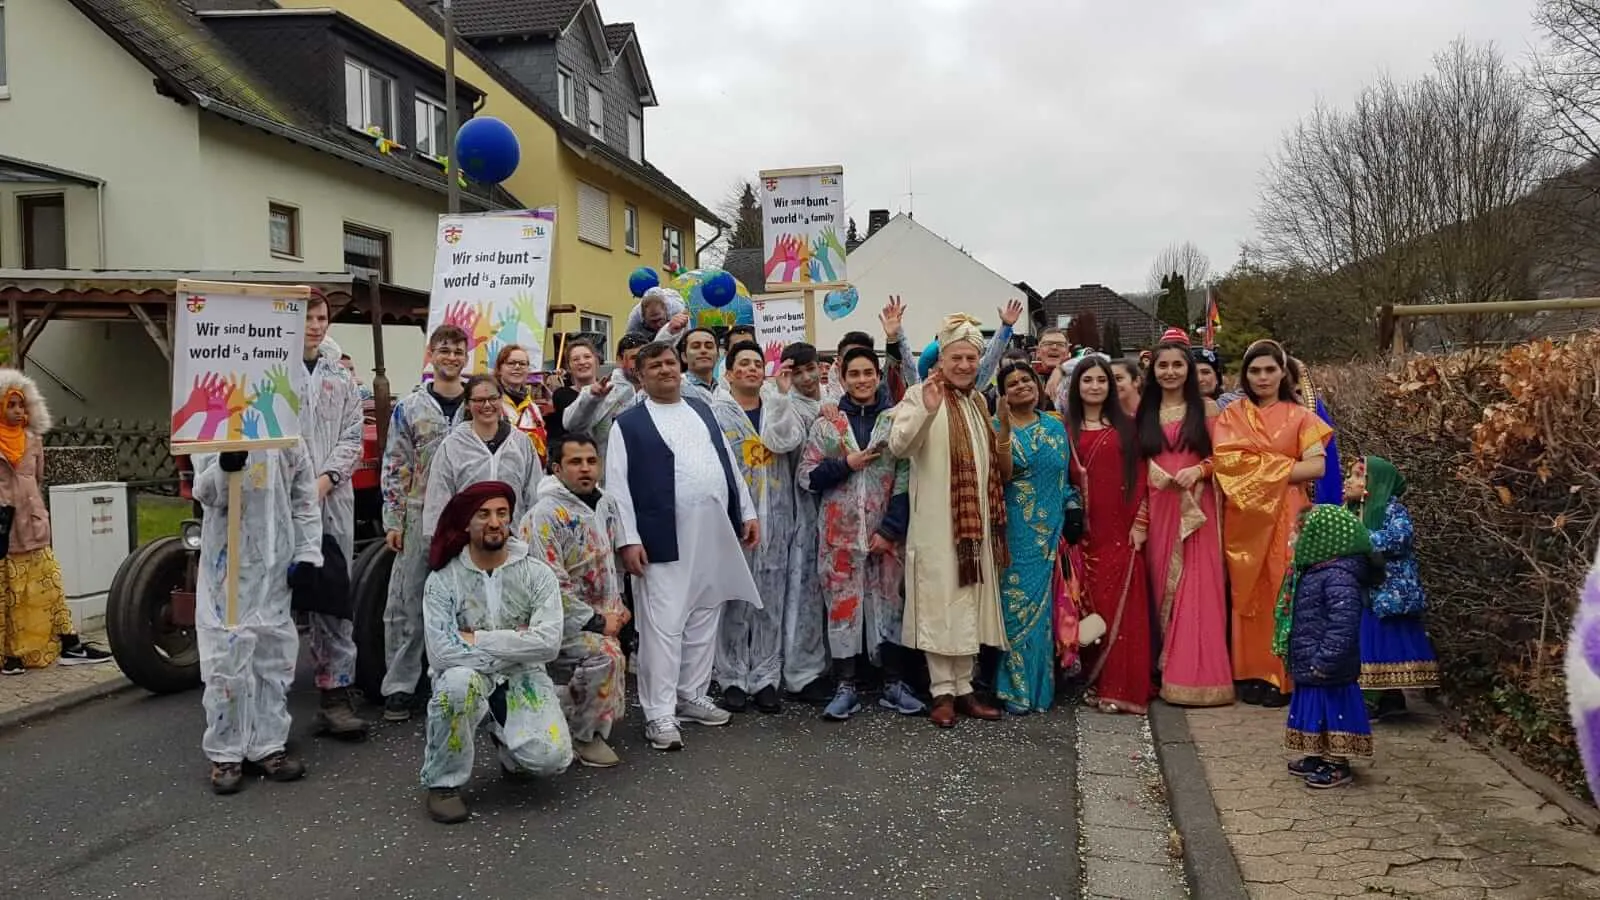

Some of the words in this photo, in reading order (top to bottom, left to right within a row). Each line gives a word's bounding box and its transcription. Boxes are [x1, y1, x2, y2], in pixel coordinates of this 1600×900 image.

[773, 197, 789, 208] Wir
[806, 196, 829, 207] bunt
[771, 212, 797, 224] world
[804, 217, 809, 225] a
[811, 212, 834, 223] family
[452, 251, 472, 265] Wir
[474, 252, 495, 262] sind
[497, 251, 529, 265] bunt
[444, 272, 480, 289] world
[482, 272, 489, 282] is
[489, 280, 496, 289] a
[499, 273, 535, 288] family
[762, 314, 774, 322] Wir
[787, 312, 805, 321] bunt
[196, 322, 220, 337] Wir
[223, 324, 246, 334] sind
[248, 323, 283, 338] bunt
[761, 324, 781, 334] world
[189, 344, 231, 360] world
[233, 344, 241, 354] is
[241, 351, 249, 361] a
[252, 347, 289, 361] family
